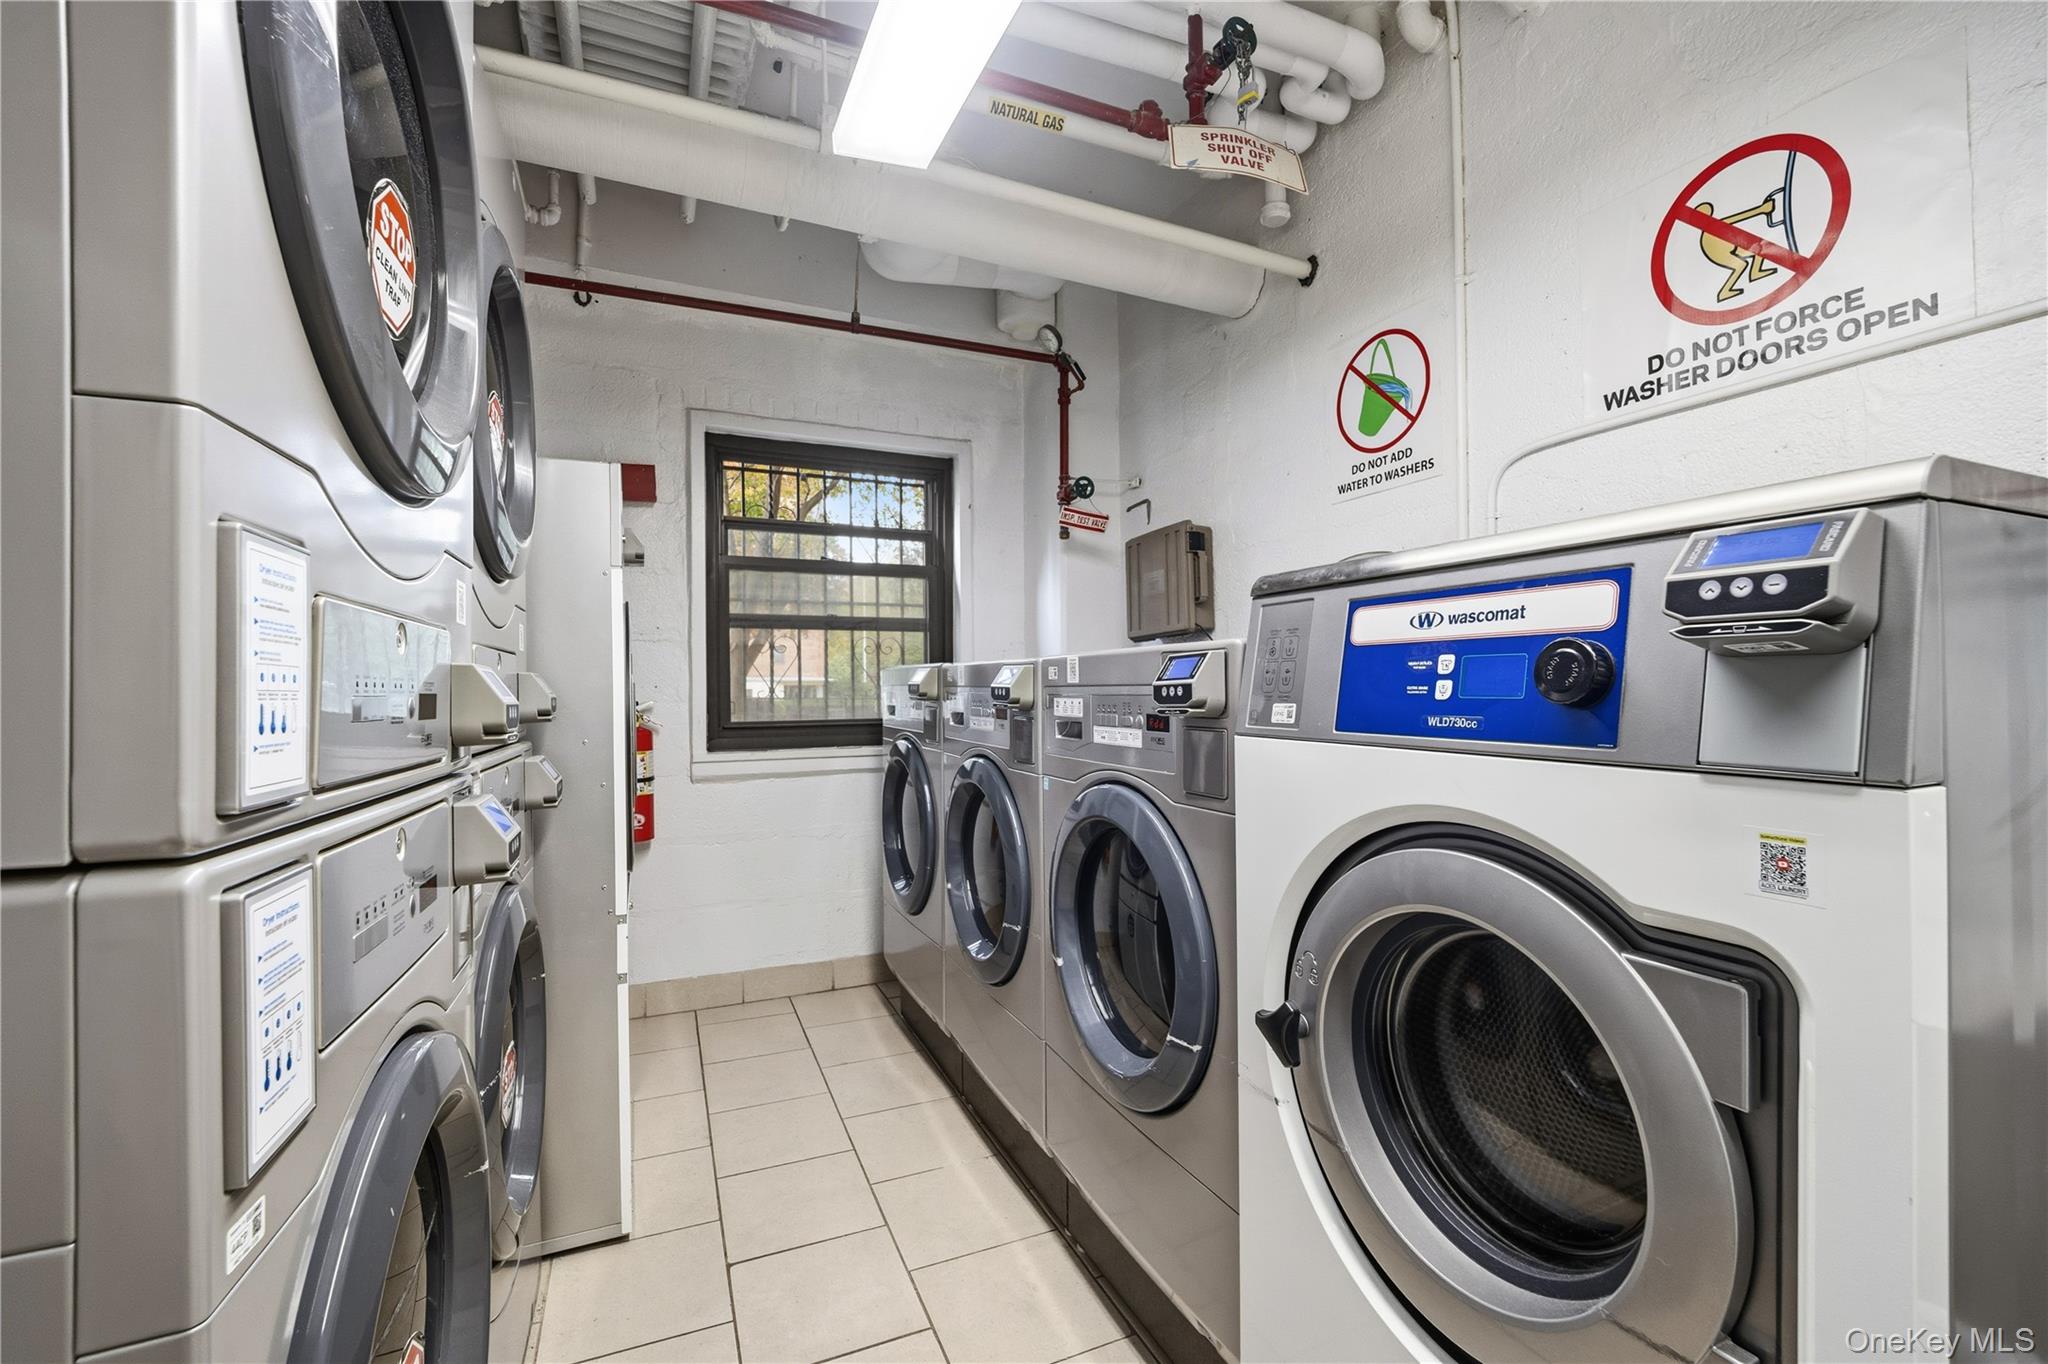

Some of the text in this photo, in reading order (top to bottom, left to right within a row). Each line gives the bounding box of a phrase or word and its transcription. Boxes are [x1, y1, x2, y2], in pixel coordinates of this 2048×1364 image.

[990, 100, 1065, 132] NATURAL GAS
[1200, 131, 1276, 156] SPRINKLER
[1207, 142, 1273, 164] SHUT OFF
[1220, 154, 1266, 172] VALVE
[380, 201, 413, 271] STOP
[376, 247, 398, 280] CLEAN
[385, 279, 402, 308] TRAP
[1647, 287, 1866, 375] DO NOT FORCE
[1603, 292, 1939, 411] WASHER DOORS OPEN
[1351, 447, 1413, 475] DO NOT ADD
[1337, 457, 1435, 495] WATER TO WASHERS
[1448, 605, 1526, 625] wascomat
[1428, 716, 1478, 729] WLD730cc
